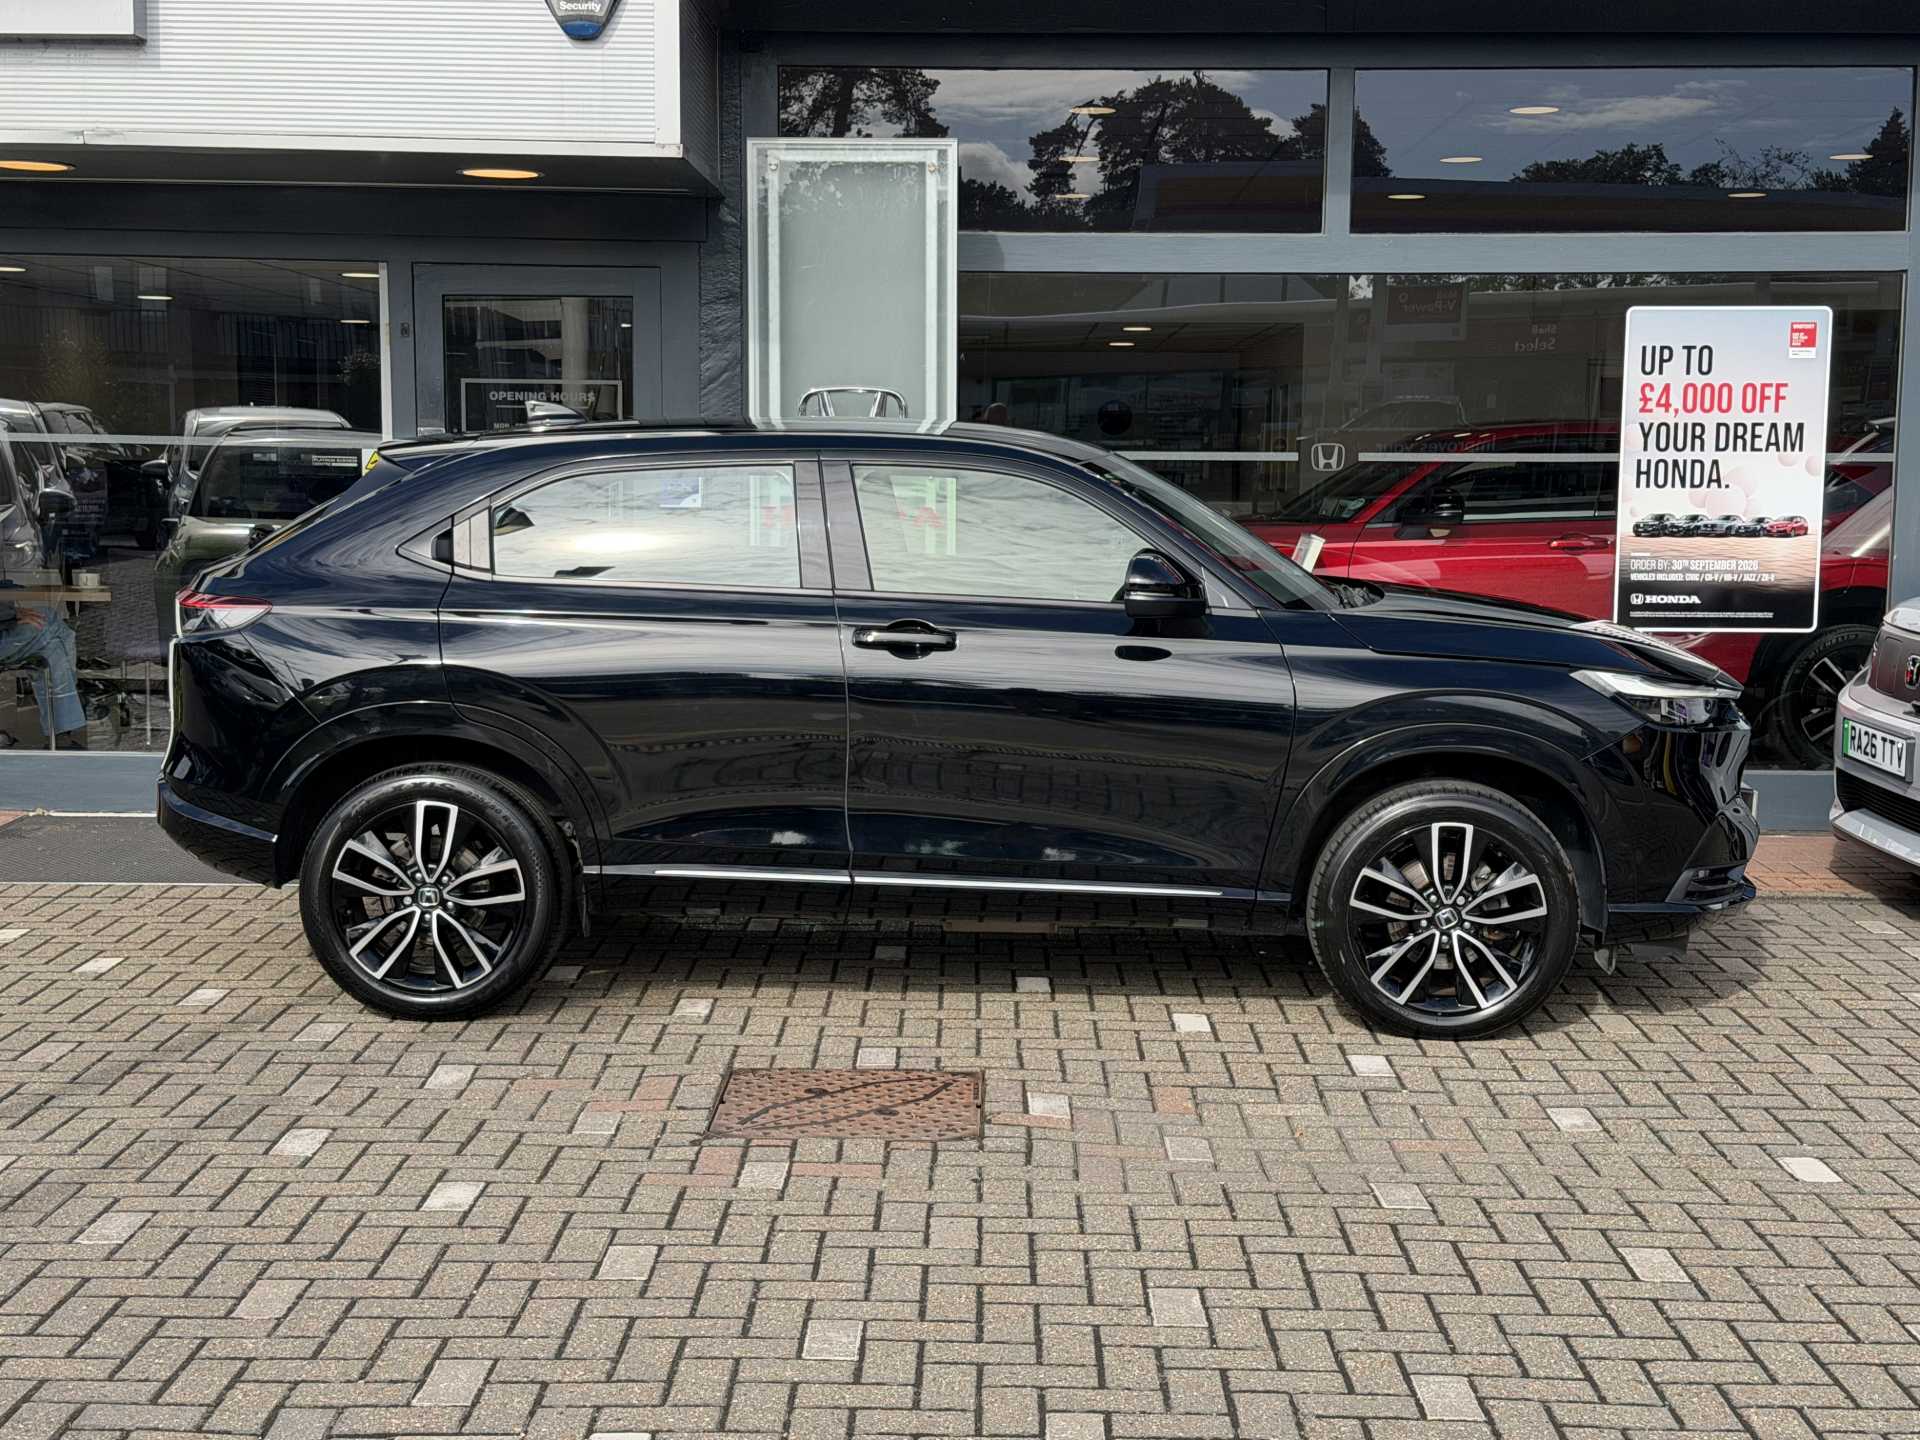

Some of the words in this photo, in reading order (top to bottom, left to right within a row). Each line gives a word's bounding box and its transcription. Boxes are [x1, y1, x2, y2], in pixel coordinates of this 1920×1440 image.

[559, 1, 602, 12] Security
[1640, 345, 1674, 376] UP
[1682, 345, 1714, 376] TO
[489, 391, 547, 401] OPENING
[550, 391, 596, 402] HOURS
[1639, 382, 1733, 418] £4,000
[1741, 383, 1789, 414] OFF
[1639, 422, 1706, 453] YOUR
[1714, 422, 1805, 453] DREAM
[1635, 459, 1730, 489] HONDA.
[1630, 559, 1656, 570] ORDER
[1657, 559, 1671, 570] BY:
[1690, 559, 1737, 571] SEPTEMBER
[1645, 594, 1701, 604] HONDA
[1850, 726, 1877, 760] RA26
[1881, 736, 1904, 769] TTV
